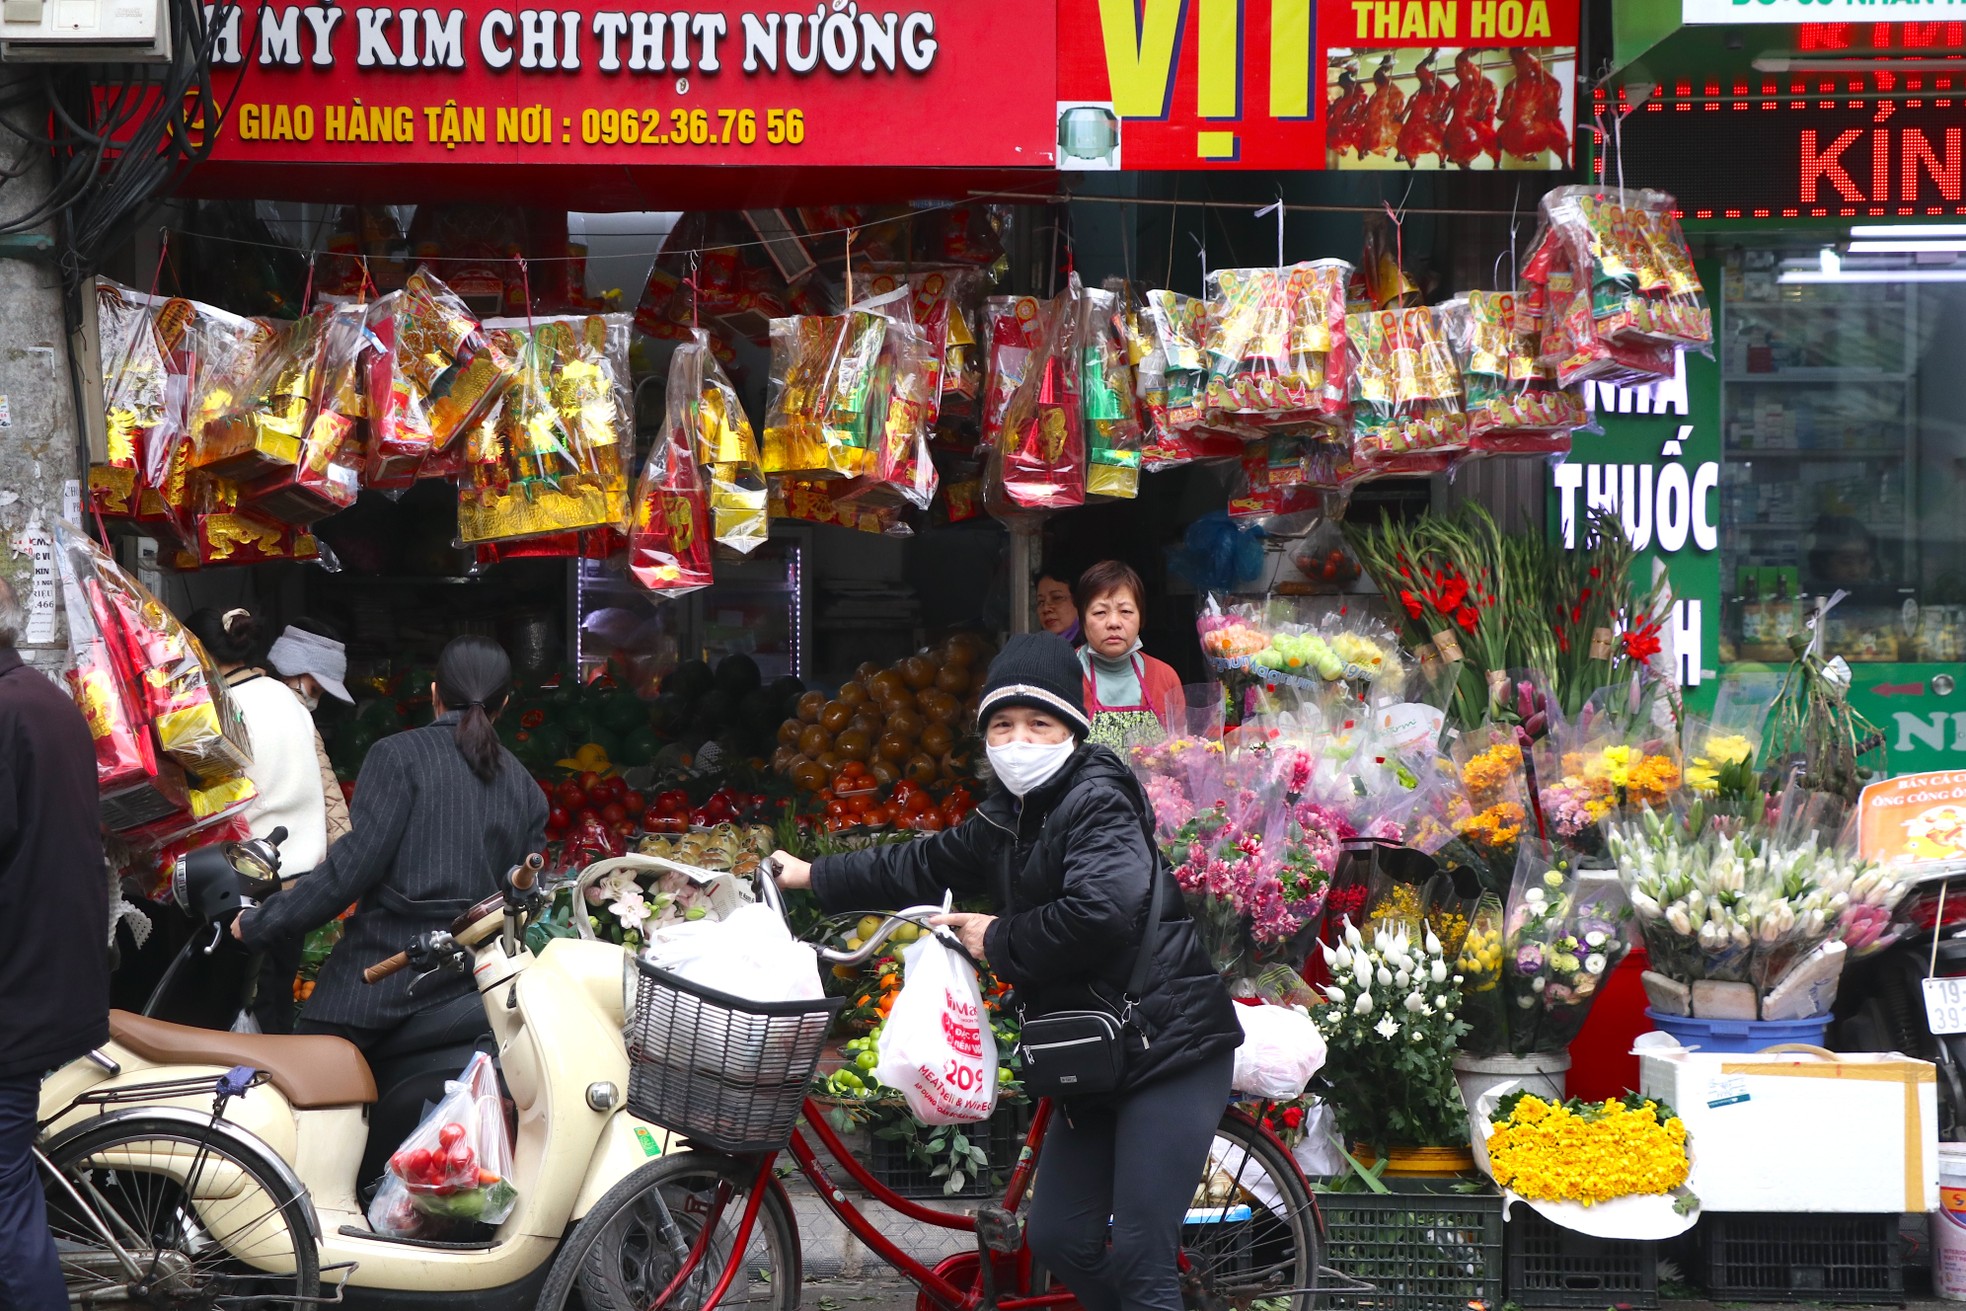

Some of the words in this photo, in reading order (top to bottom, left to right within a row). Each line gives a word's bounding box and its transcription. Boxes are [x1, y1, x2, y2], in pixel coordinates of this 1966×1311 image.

[356, 7, 467, 68] KIM
[479, 8, 582, 71] CHI
[592, 10, 728, 95] THỊT
[741, 0, 938, 73] NƯỚNG
[1352, 0, 1457, 39] THAN
[239, 103, 315, 141] GIAO
[325, 97, 414, 143] HÀNG
[424, 99, 486, 150] TẬN
[496, 104, 552, 144] NƠI
[581, 108, 756, 145] 0962.36.76
[767, 108, 805, 145] 56
[1801, 100, 1961, 203] KÍN
[1554, 425, 1719, 552] THUỐC
